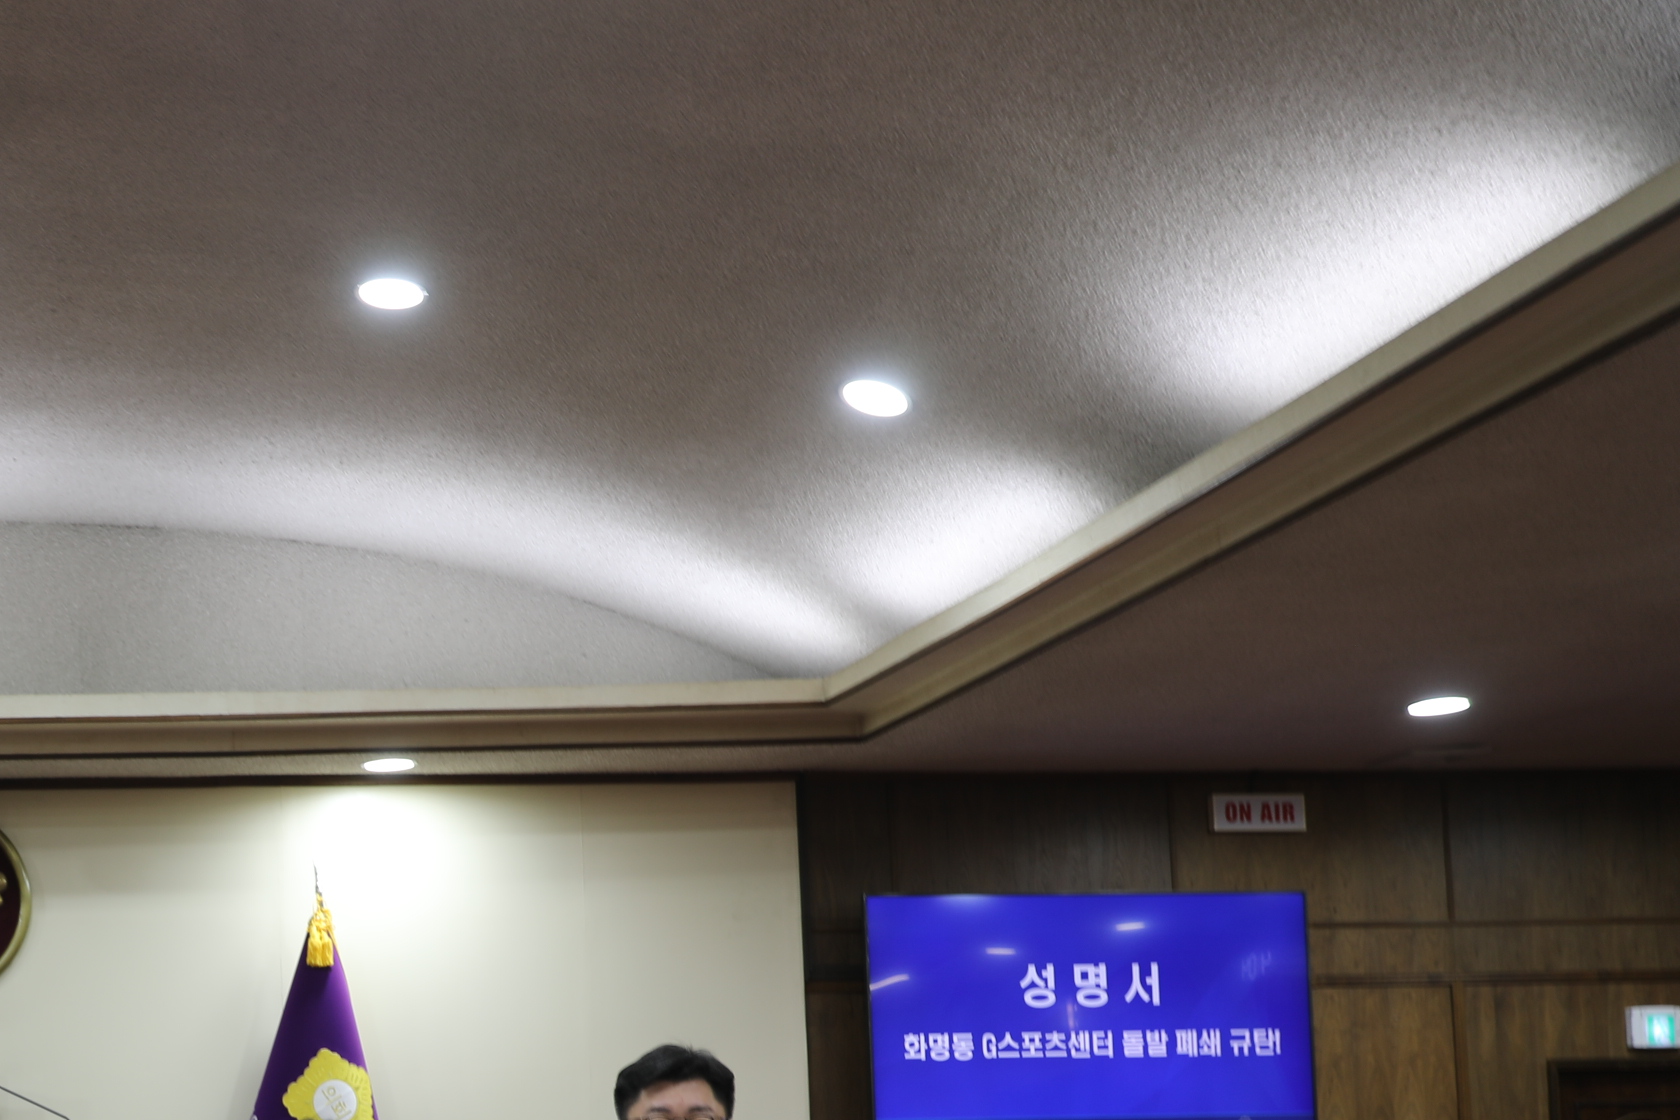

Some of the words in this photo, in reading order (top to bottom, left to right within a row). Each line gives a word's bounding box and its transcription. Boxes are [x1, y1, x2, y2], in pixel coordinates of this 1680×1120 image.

[1225, 801, 1252, 824] ON
[1260, 801, 1295, 824] AIR
[903, 1032, 975, 1062] 화명동
[981, 1031, 1114, 1060] G스포츠센터
[1122, 1029, 1169, 1058] 돌발
[1175, 1028, 1222, 1058] 폐쇄
[1229, 1027, 1281, 1057] 규탄!
